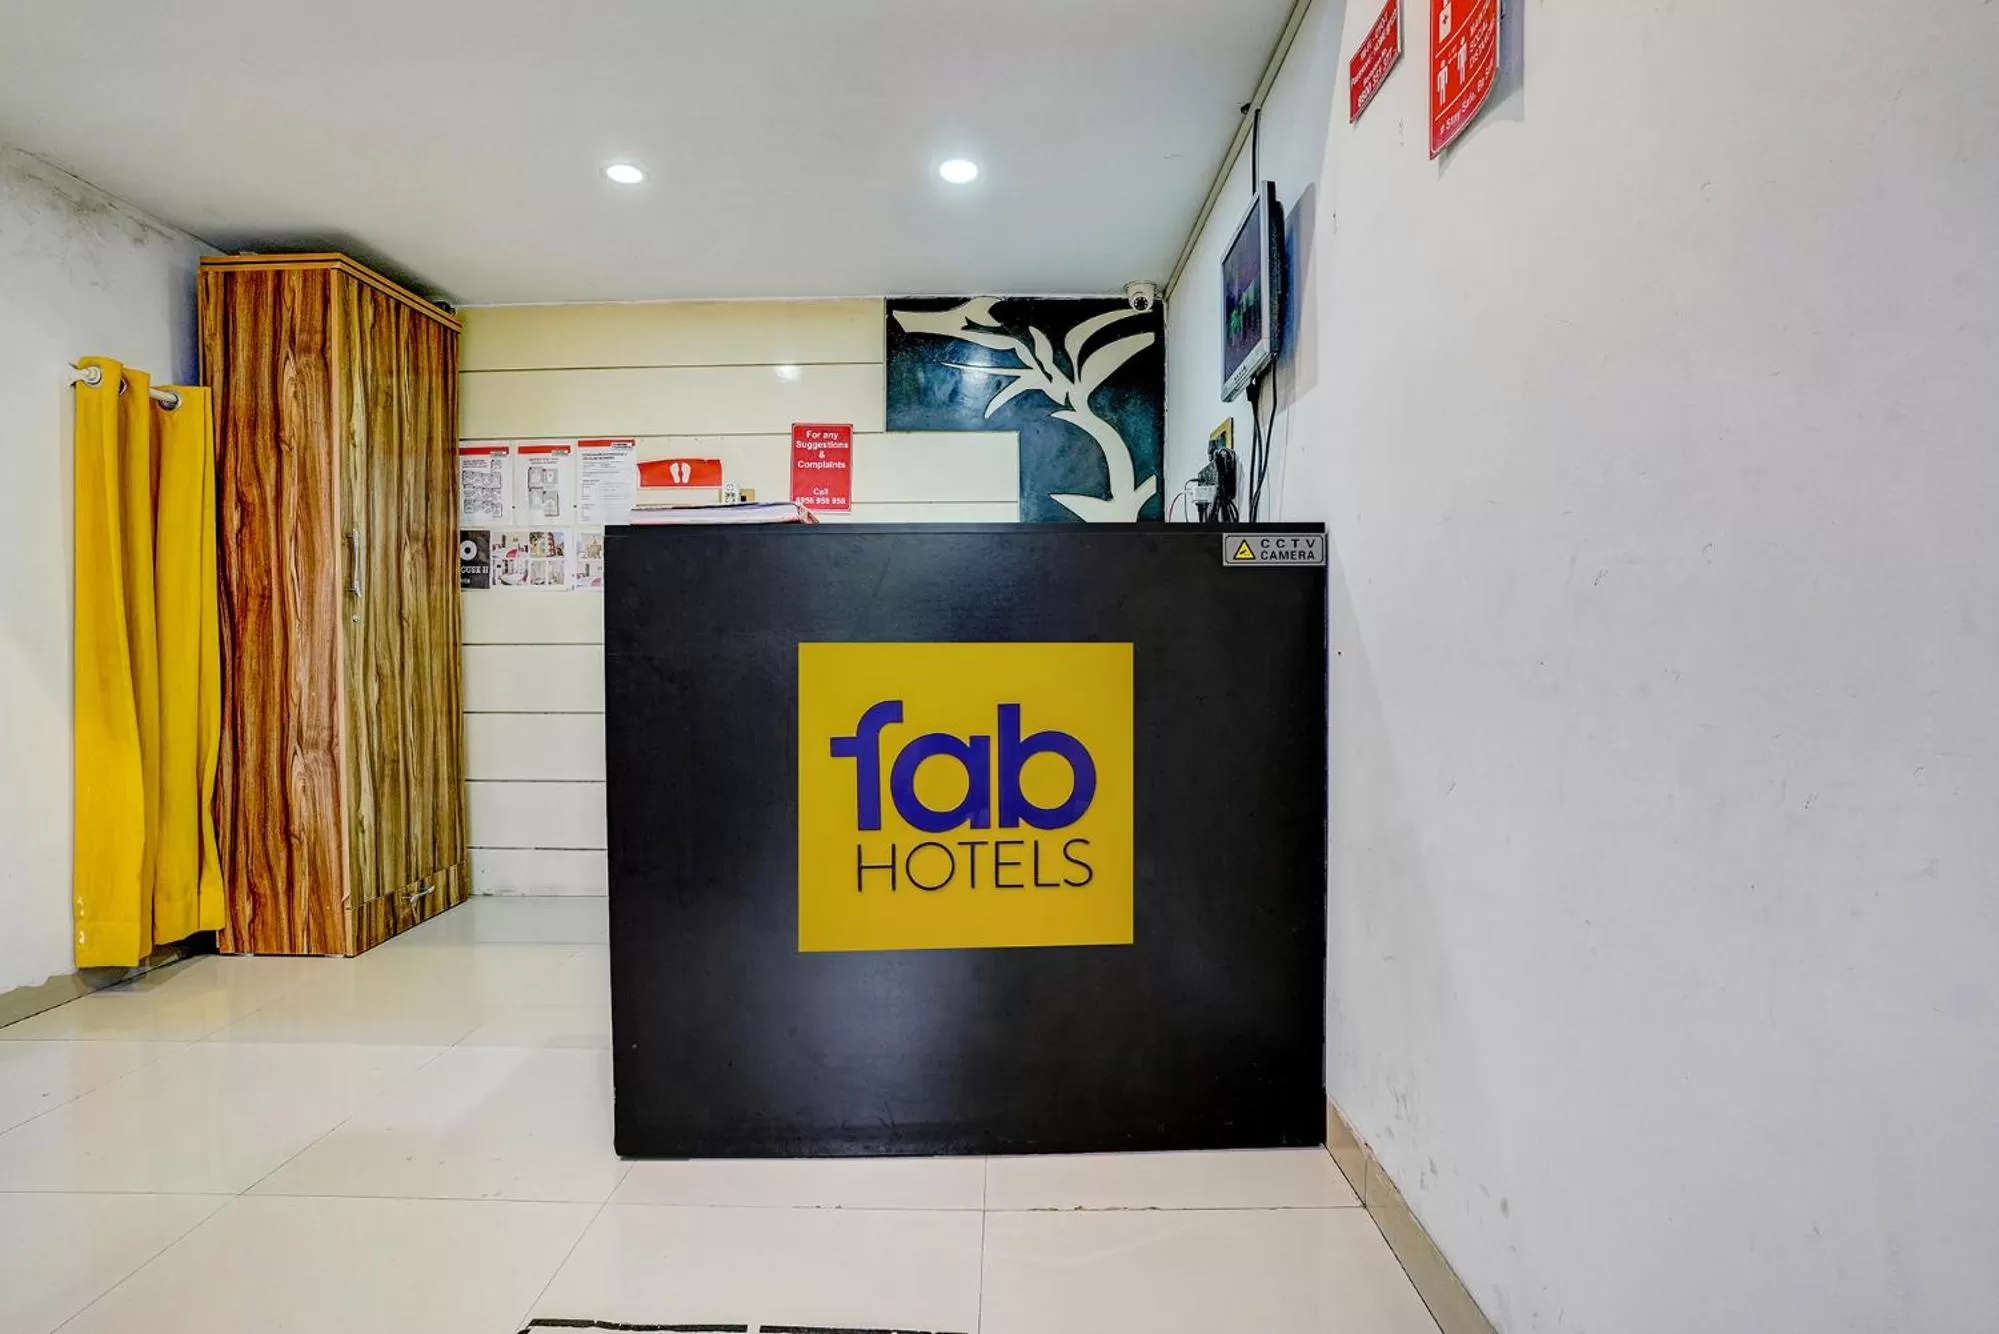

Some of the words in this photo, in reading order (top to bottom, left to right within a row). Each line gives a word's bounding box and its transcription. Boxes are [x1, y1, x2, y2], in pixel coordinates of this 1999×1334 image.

[806, 430, 821, 439] For
[823, 432, 839, 441] any
[795, 440, 849, 450] Suggestions
[797, 461, 846, 470] Complaints
[813, 487, 829, 495] Call
[1260, 538, 1316, 548] CCTV
[1260, 550, 1315, 560] CAMERA
[830, 700, 1097, 833] fab
[857, 838, 1094, 893] HOTELS
